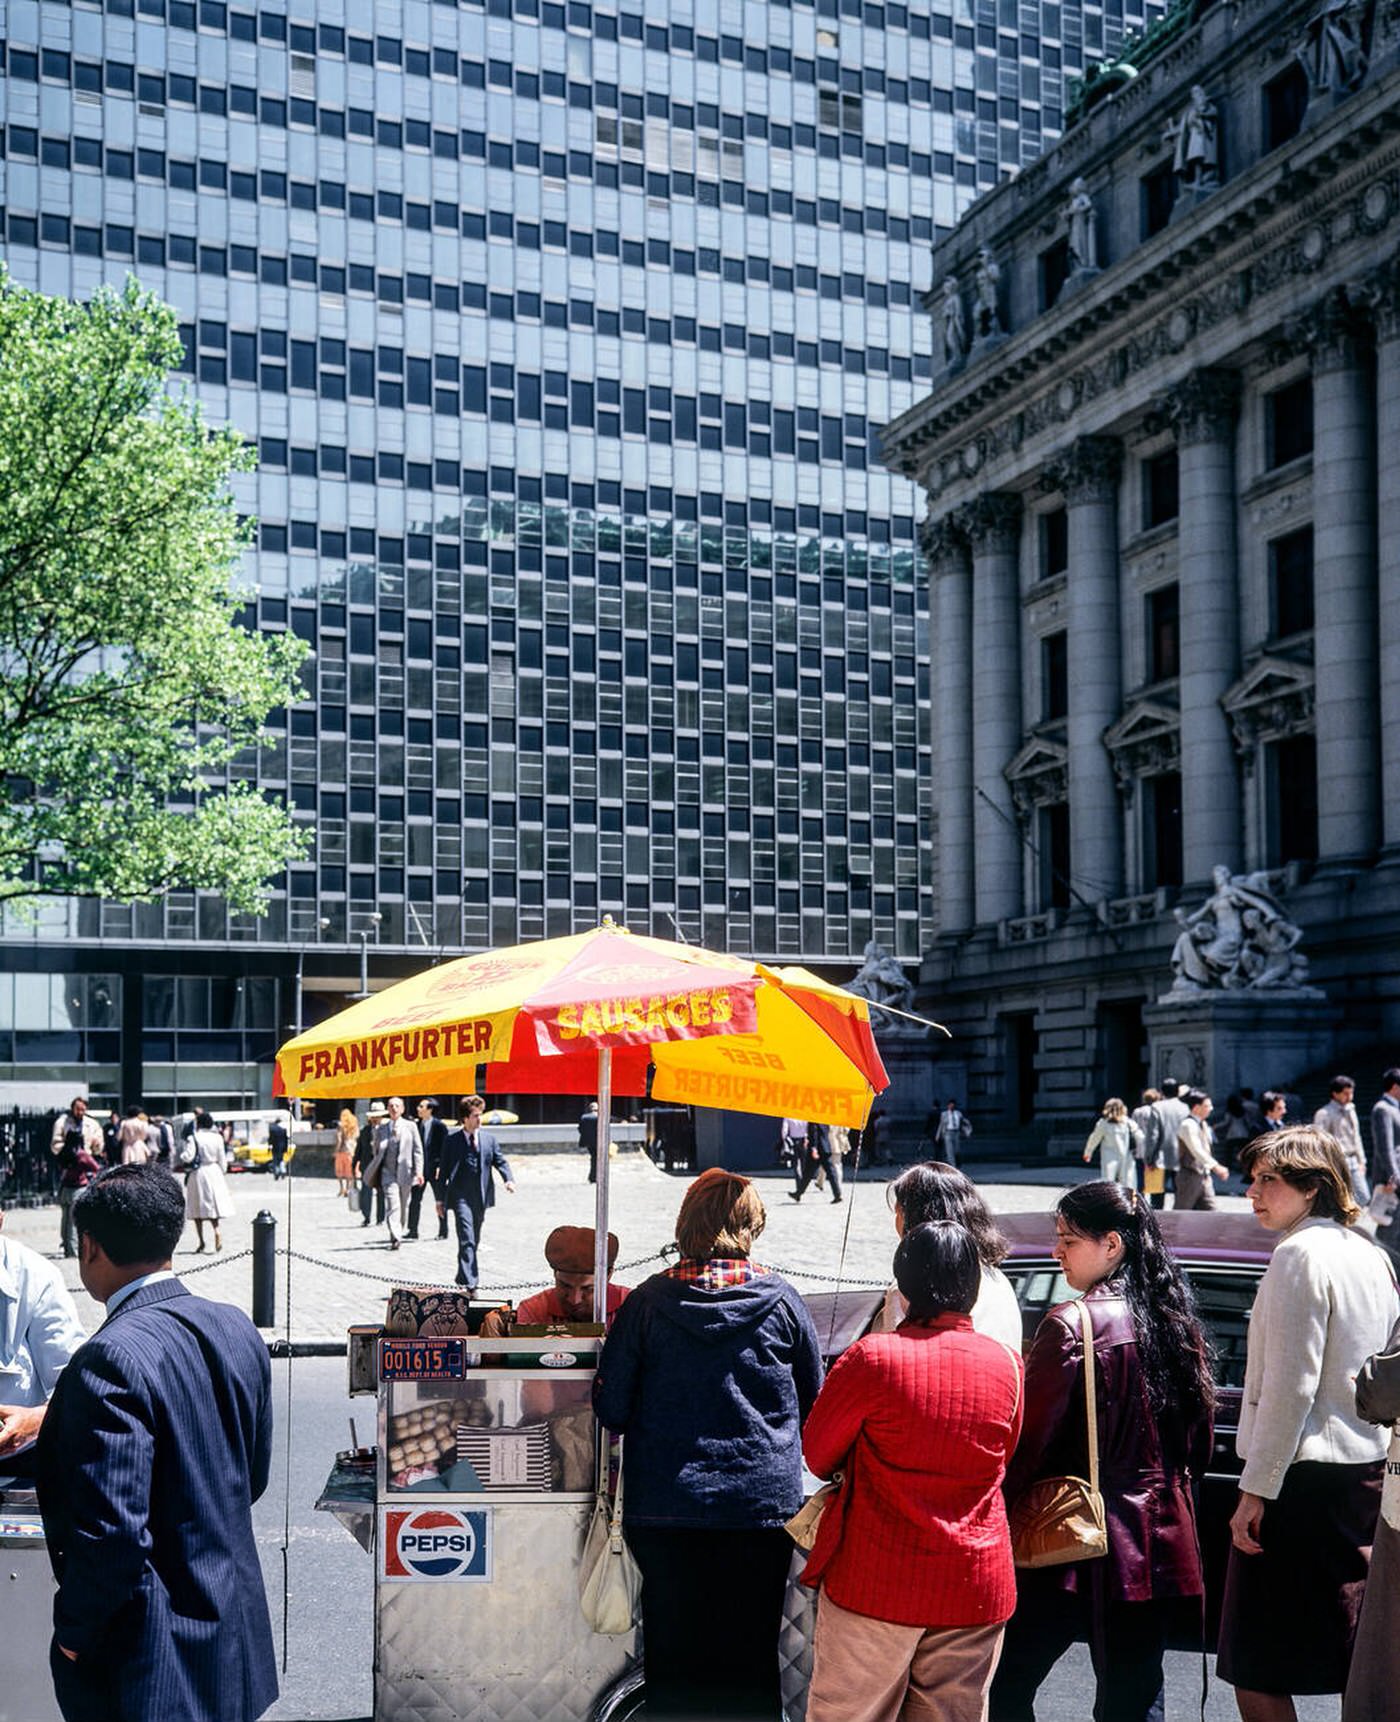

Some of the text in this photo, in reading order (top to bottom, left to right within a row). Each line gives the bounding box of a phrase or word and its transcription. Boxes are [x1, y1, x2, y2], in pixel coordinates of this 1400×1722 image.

[557, 989, 733, 1040] SAUSAGES
[299, 1020, 493, 1083] FRANKFURTER
[384, 1350, 443, 1370] 001615
[401, 1535, 471, 1552] PEPSI
